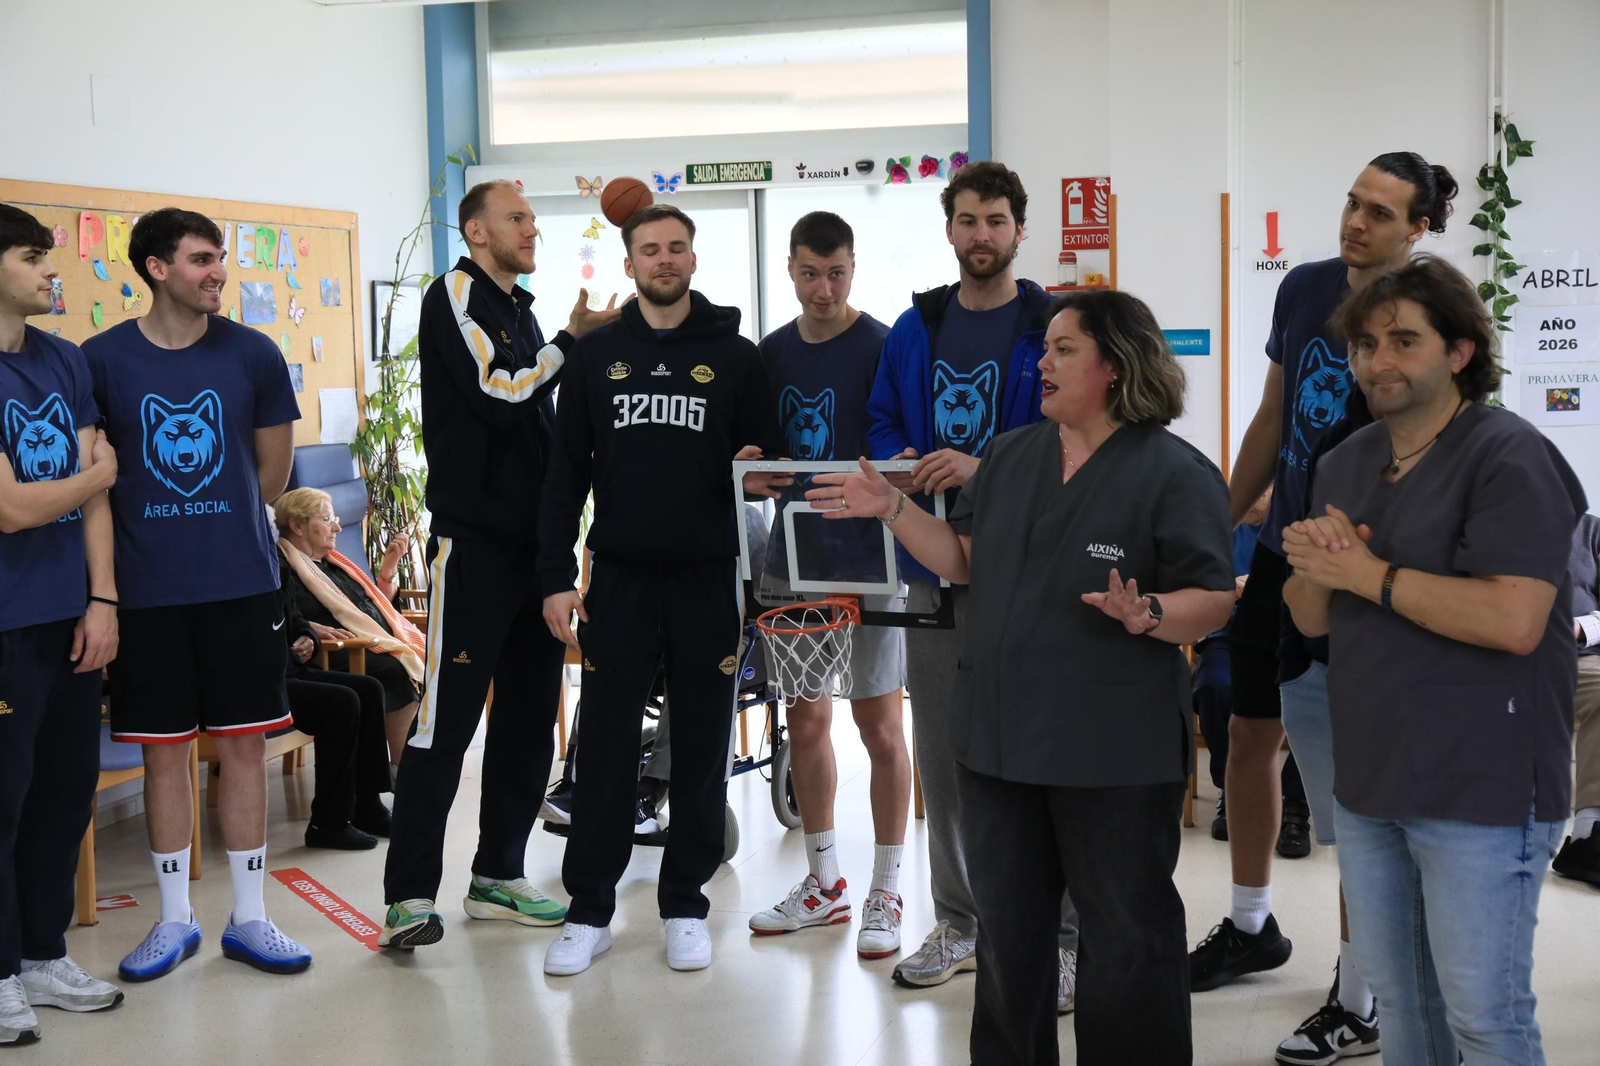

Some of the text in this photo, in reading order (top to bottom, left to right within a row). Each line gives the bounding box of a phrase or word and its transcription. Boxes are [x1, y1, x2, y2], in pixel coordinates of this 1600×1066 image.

[693, 162, 766, 183] SALIDA EMERGENCIA
[807, 170, 841, 179] XARDÍN
[1063, 233, 1109, 245] EXTINTOR
[1256, 260, 1289, 271] HOXE
[1522, 268, 1599, 289] ABRIL
[1539, 316, 1577, 331] AÑO
[1538, 338, 1578, 351] 2026
[1528, 374, 1599, 384] PRIMAVERA
[613, 394, 707, 432] 32005
[144, 500, 232, 518] ÁREA SOCIAL
[1086, 542, 1125, 558] AIXIÑA
[1091, 552, 1119, 562] ourense
[796, 594, 806, 602] XL
[291, 879, 378, 937] ESPERAR TURNO ASEO
